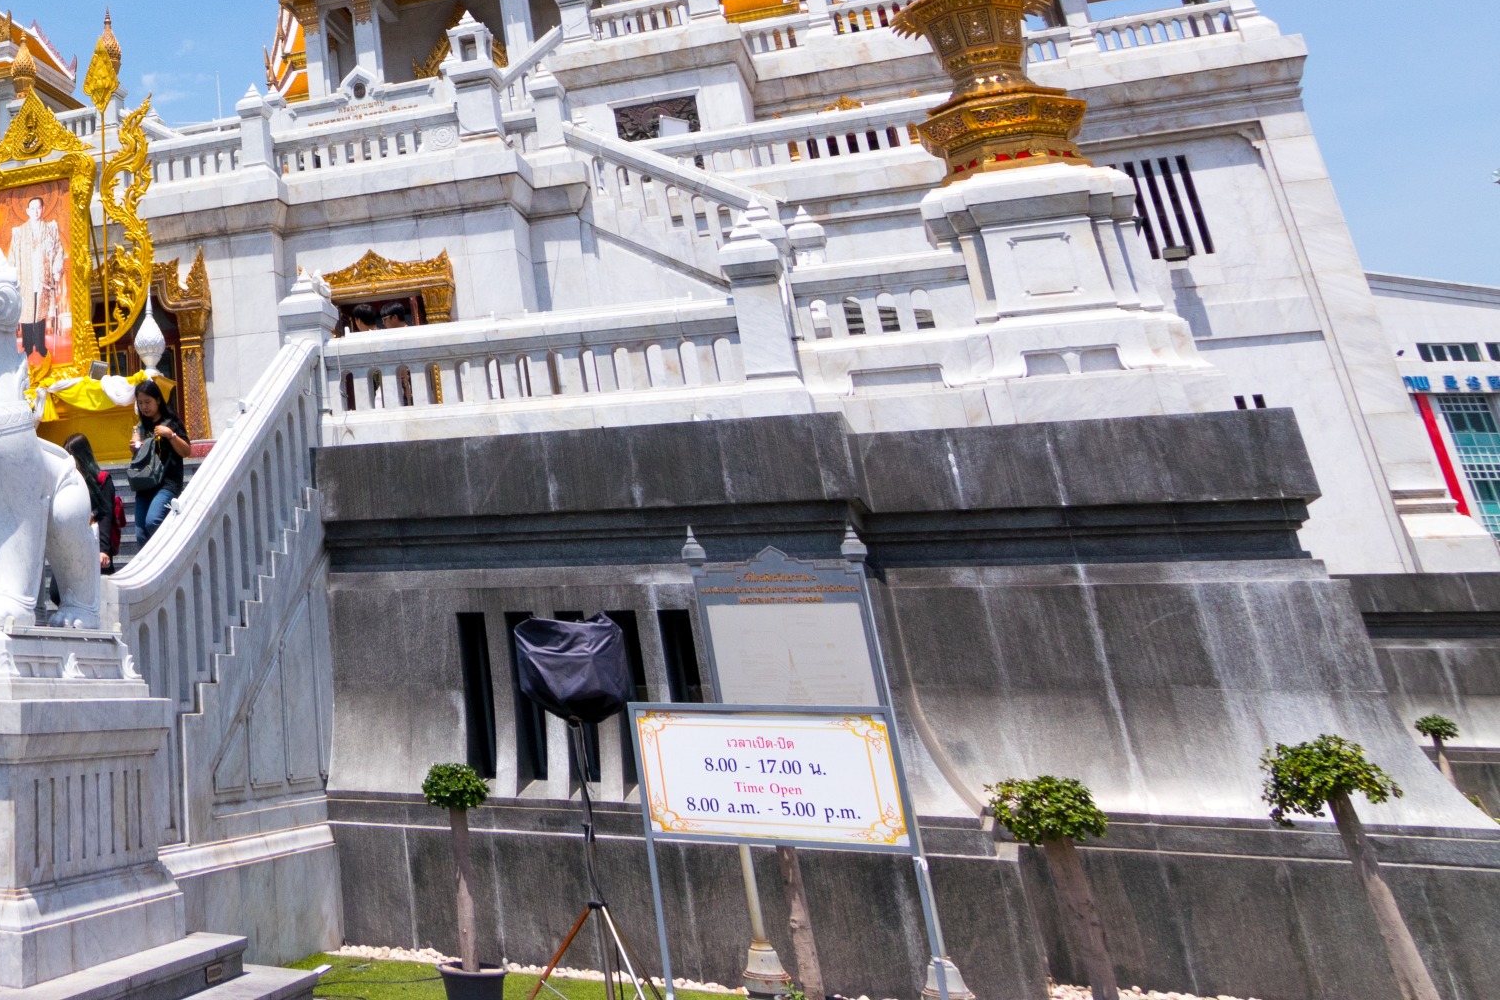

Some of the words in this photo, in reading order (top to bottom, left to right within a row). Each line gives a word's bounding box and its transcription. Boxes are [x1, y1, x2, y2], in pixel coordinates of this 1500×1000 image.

[727, 736, 795, 750] เวลาเปิด-ปิด
[704, 757, 738, 773] 8.00
[757, 758, 802, 775] 17.00
[808, 761, 827, 776] น.
[734, 781, 765, 794] Time
[769, 782, 803, 798] Open
[686, 796, 720, 813] 8.00
[727, 802, 761, 815] a.m.
[780, 801, 816, 818] 5.00
[824, 807, 862, 823] p.m.
